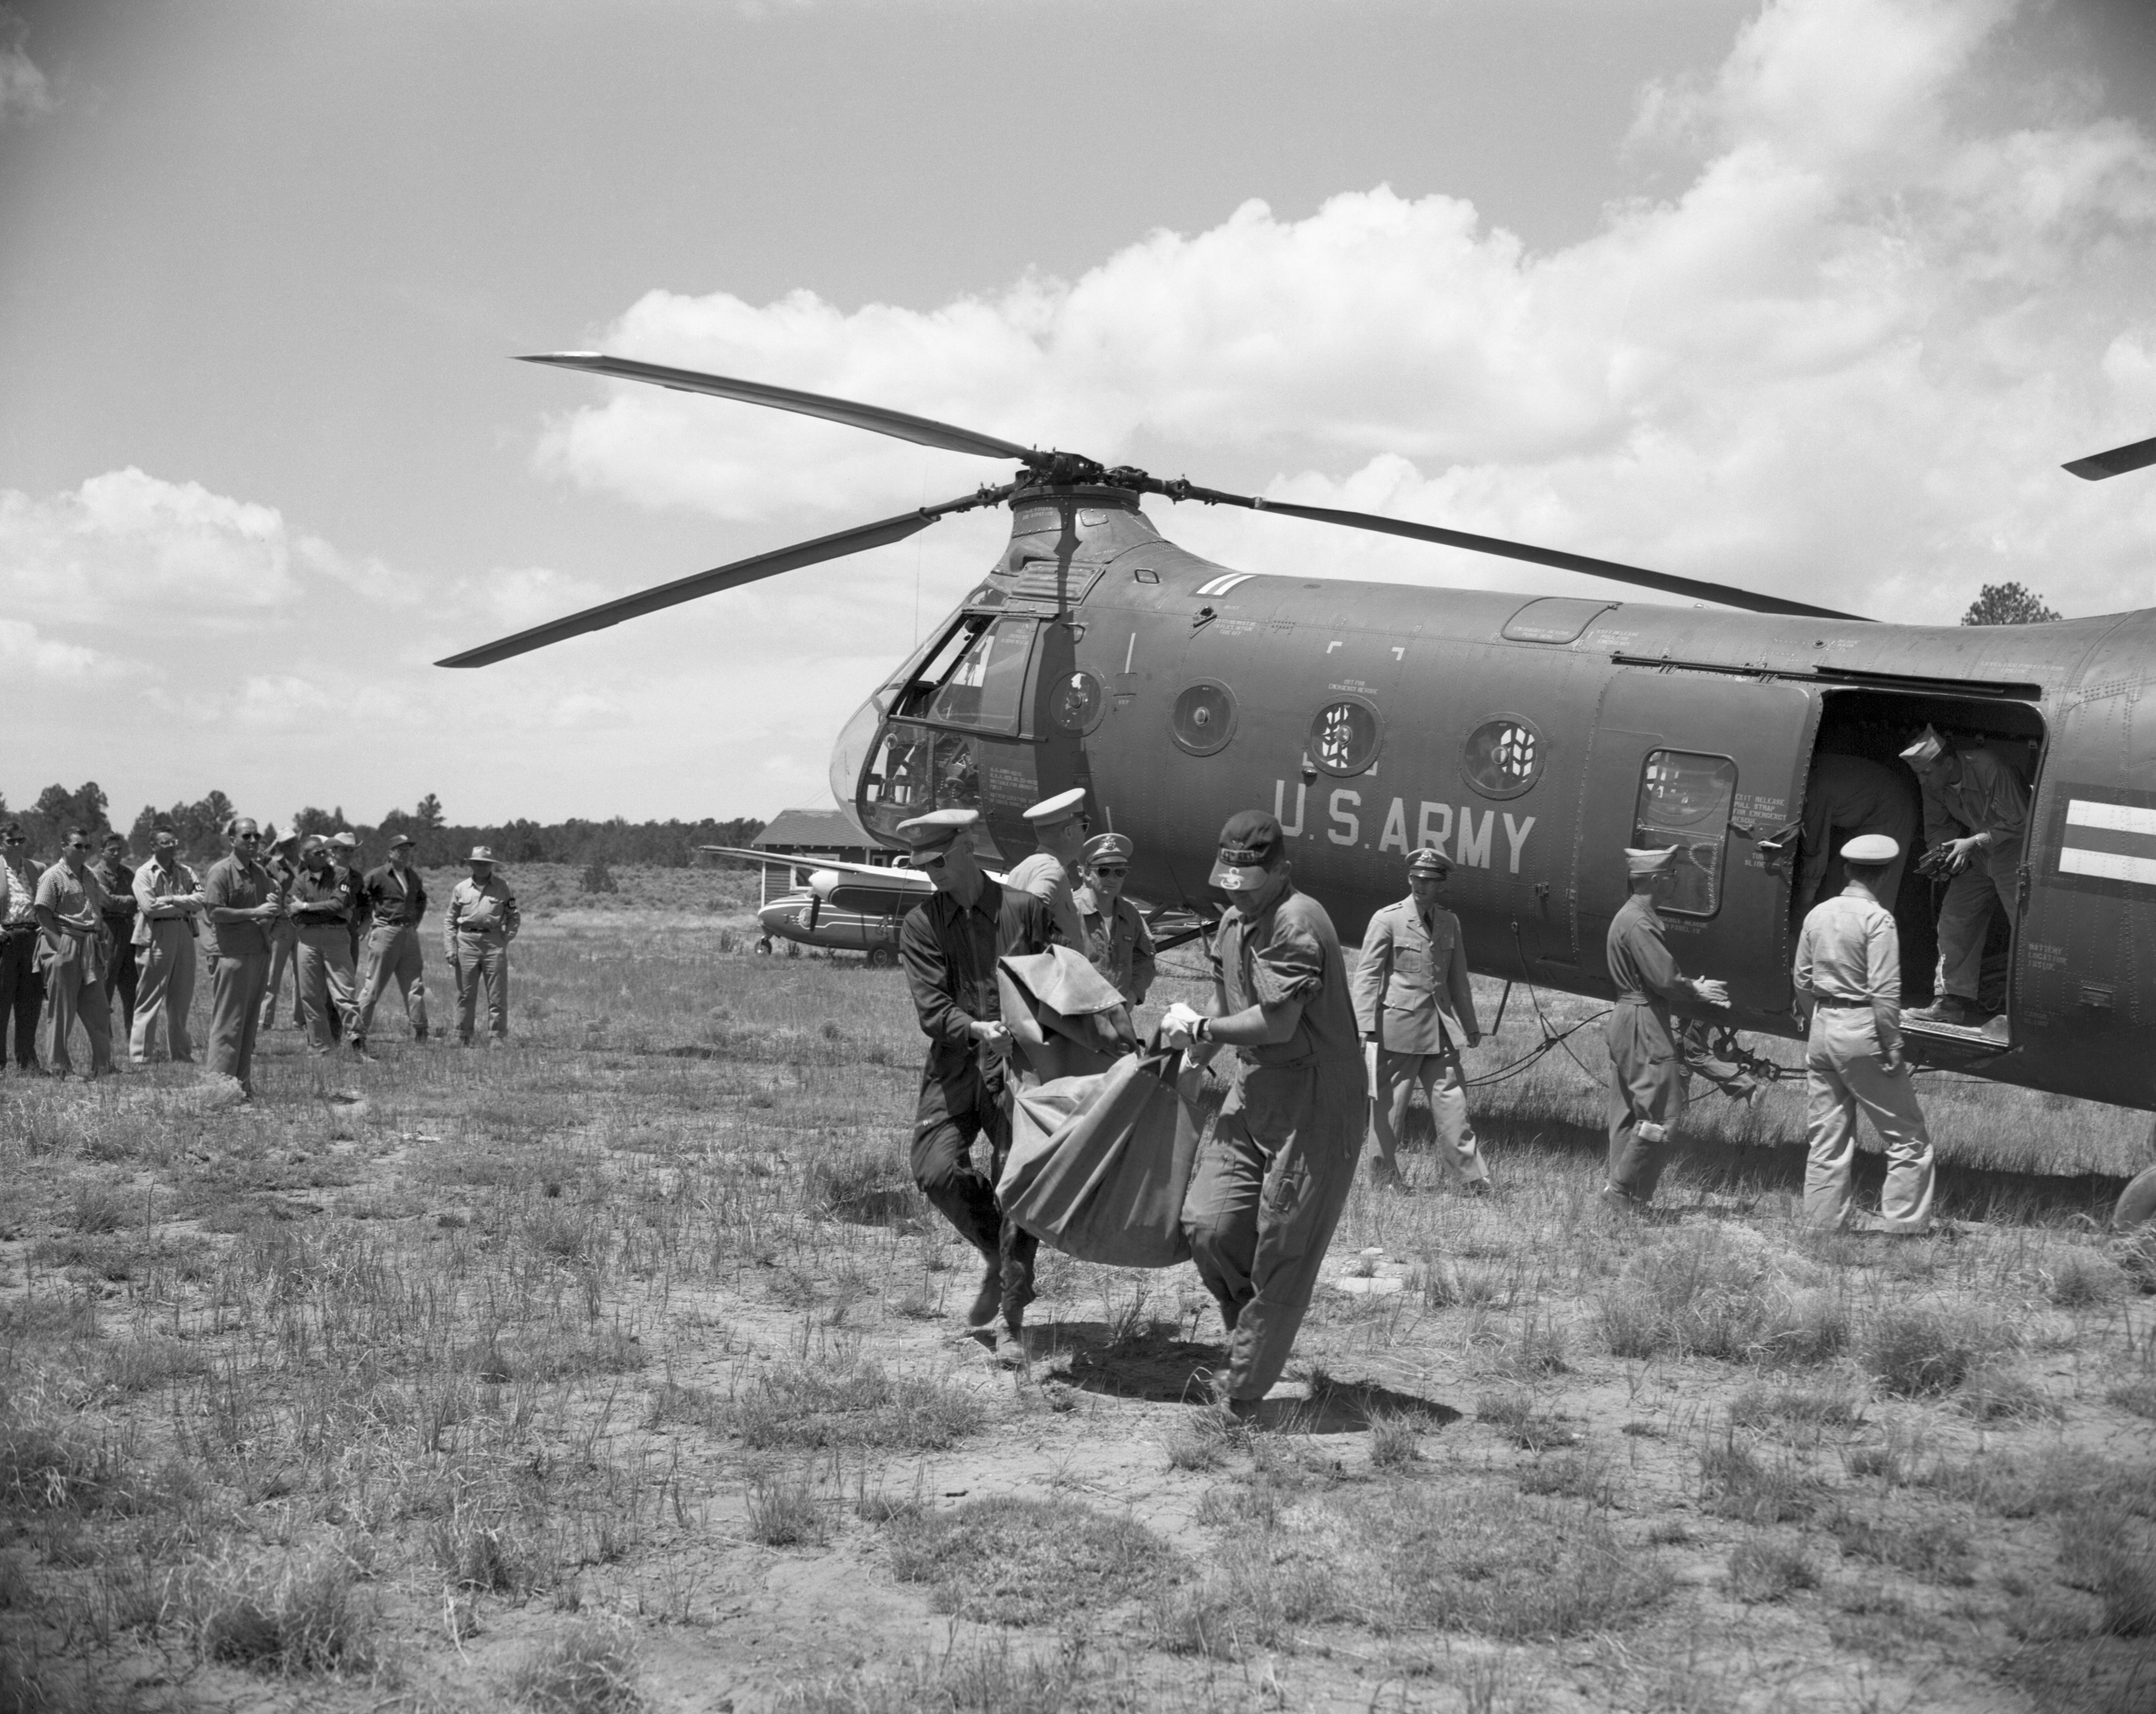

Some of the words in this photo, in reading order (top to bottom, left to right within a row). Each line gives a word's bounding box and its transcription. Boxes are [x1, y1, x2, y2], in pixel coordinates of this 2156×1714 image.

[1328, 684, 1357, 692] EMERGENCY
[1735, 793, 1752, 802] EXIT
[1755, 796, 1785, 806] RELEASE
[1754, 803, 1776, 812] STRAP
[1732, 815, 1757, 825] RESCUE
[1749, 810, 1787, 821] EMERGENCY
[1378, 797, 1536, 874] ARMY
[1745, 859, 1765, 868] SLIDE
[1670, 923, 1690, 933] PANEL
[1684, 920, 1708, 928] RESCUE
[2029, 943, 2062, 955] BATTERY
[2028, 952, 2068, 964] LOCATION
